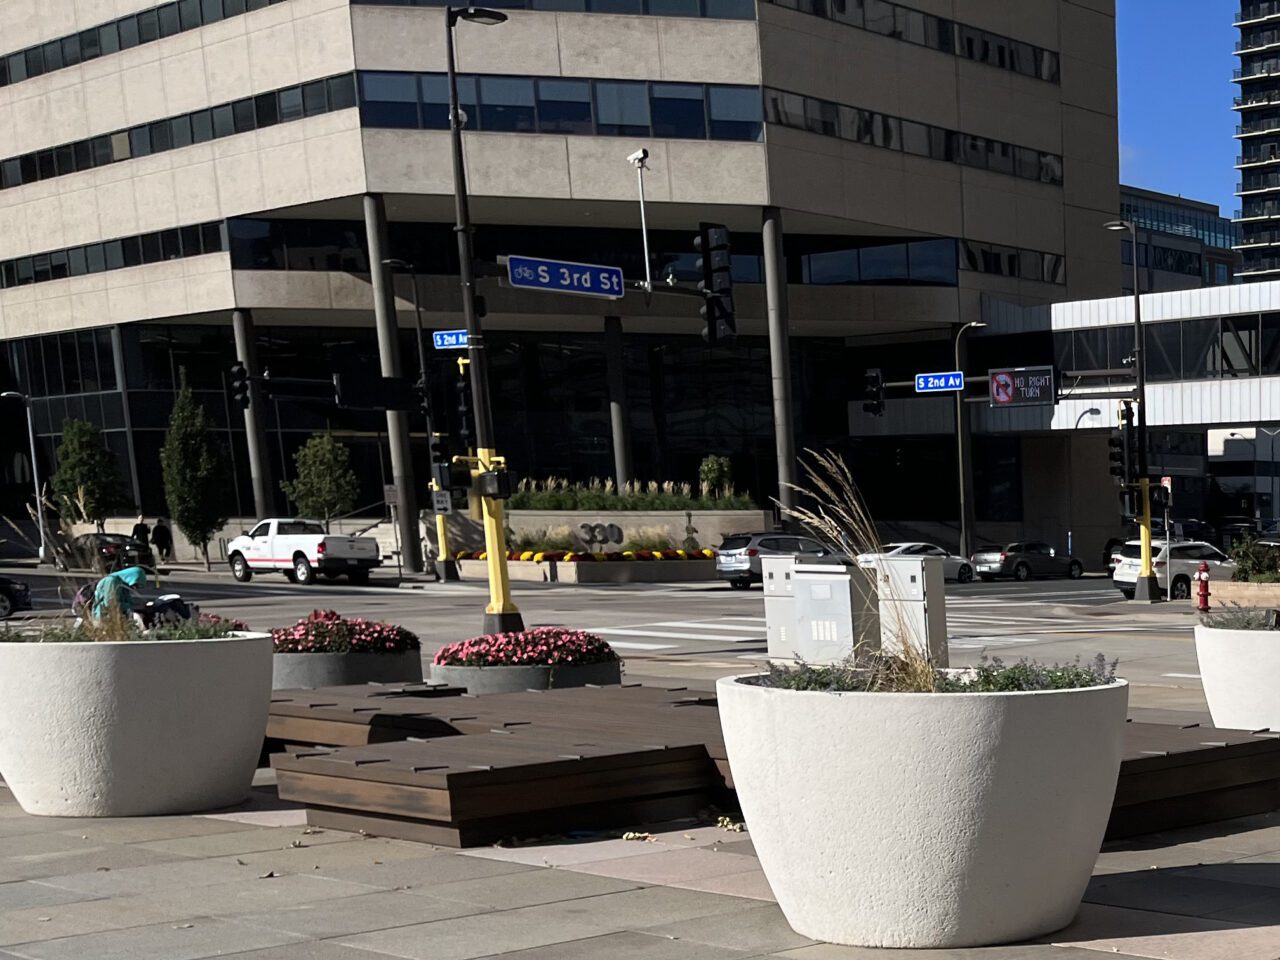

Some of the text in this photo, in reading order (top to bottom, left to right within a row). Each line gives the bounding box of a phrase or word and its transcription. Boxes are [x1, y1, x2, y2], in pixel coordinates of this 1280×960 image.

[537, 265, 619, 290] S 3rd St
[436, 334, 442, 345] S
[443, 334, 456, 345] 2nd
[918, 375, 961, 389] S 2nd Av
[1028, 375, 1050, 387] RIGHT
[1020, 386, 1040, 398] TURN
